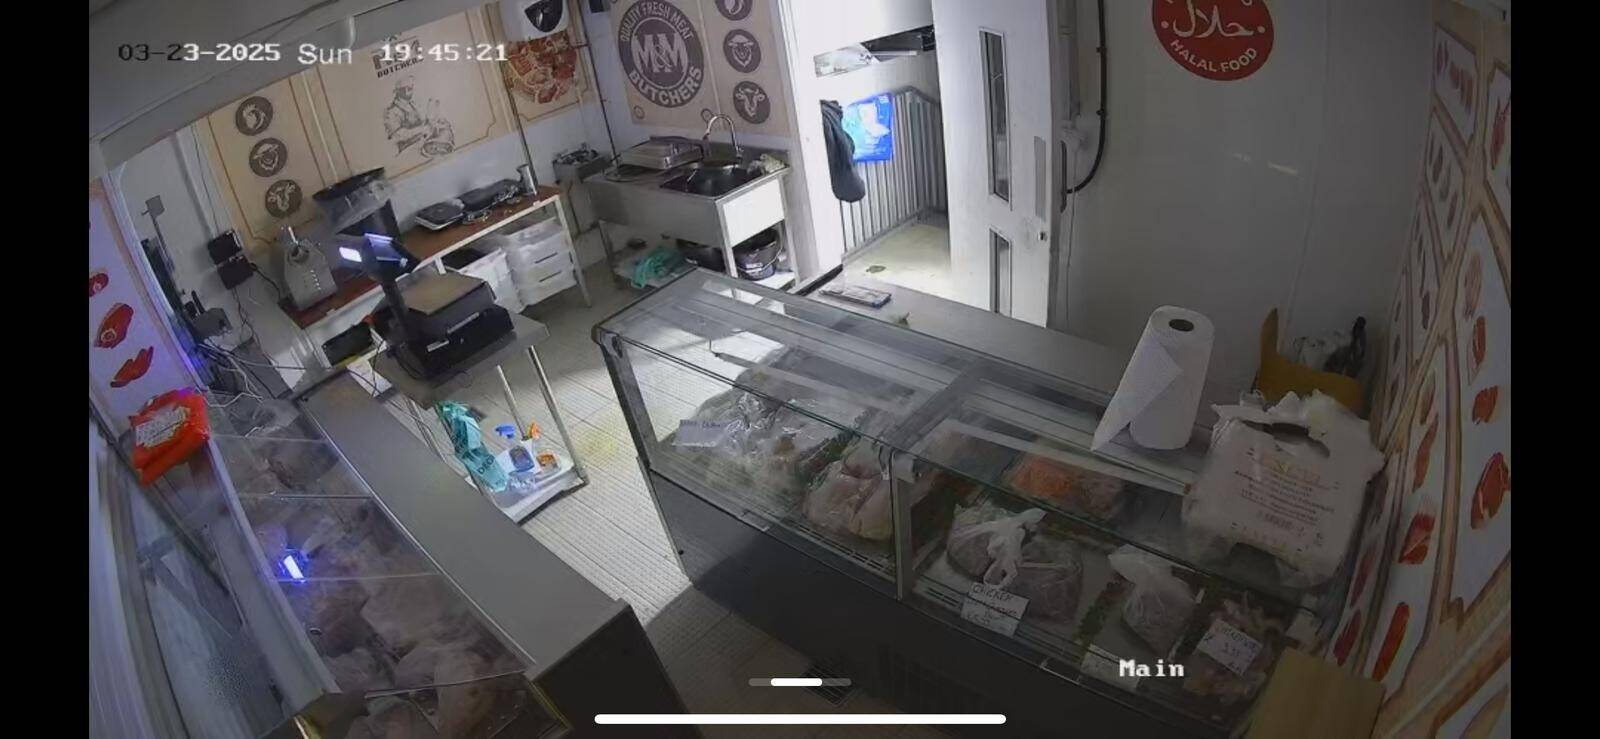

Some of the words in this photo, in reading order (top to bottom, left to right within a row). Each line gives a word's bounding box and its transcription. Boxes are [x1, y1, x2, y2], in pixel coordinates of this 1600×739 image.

[620, 6, 640, 41] QUALITY
[641, 1, 672, 19] FRESH
[670, 12, 694, 40] MEAT
[631, 32, 688, 73] M&M
[1170, 39, 1218, 73] HALAL
[1220, 47, 1257, 73] FOOD
[629, 66, 701, 105] BUTCHERS
